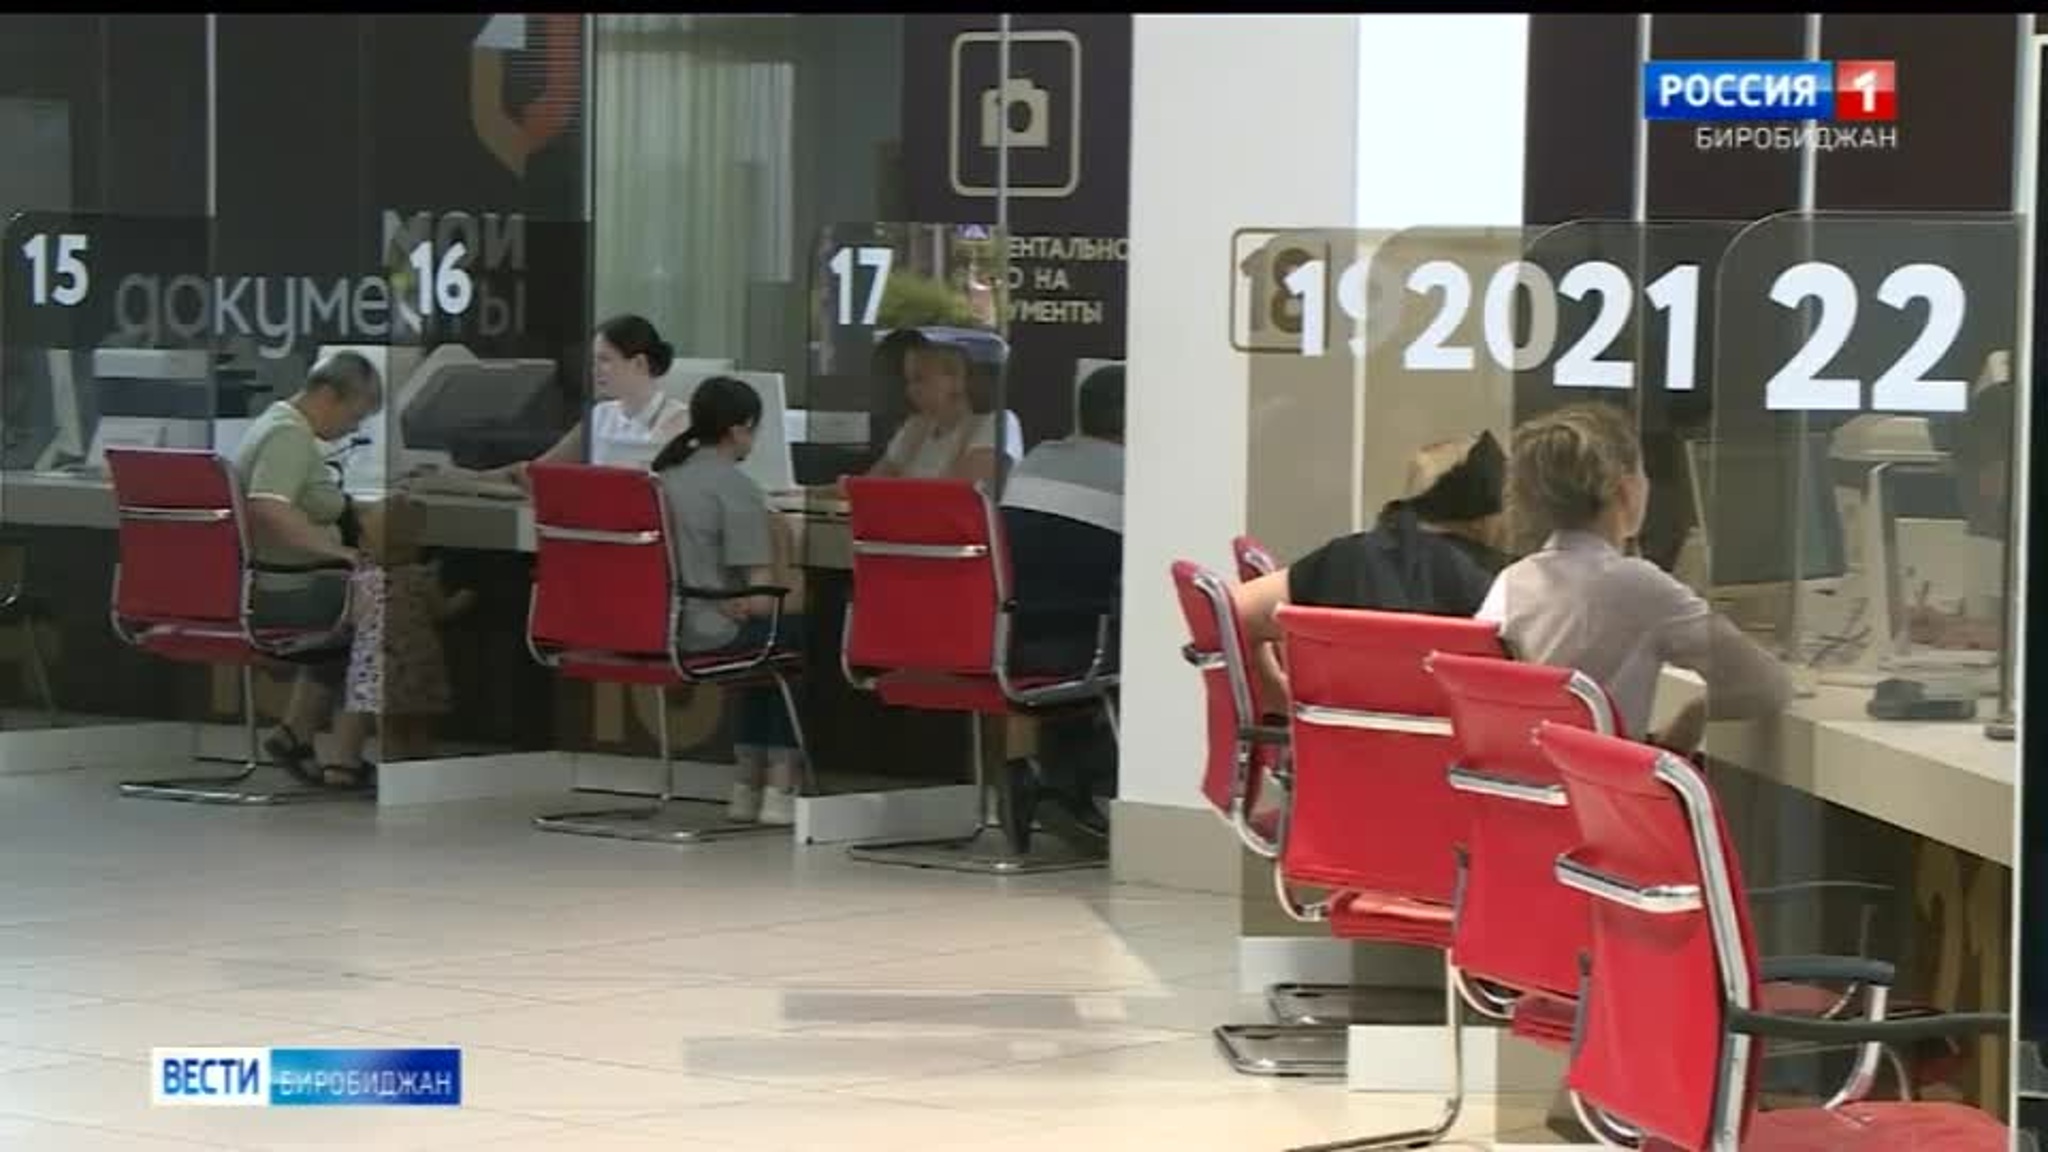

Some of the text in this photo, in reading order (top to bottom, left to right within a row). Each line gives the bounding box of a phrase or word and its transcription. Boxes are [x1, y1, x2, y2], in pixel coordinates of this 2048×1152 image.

[22, 233, 90, 306] 15
[408, 240, 473, 315] 16
[829, 246, 893, 325] 17
[1007, 236, 1129, 261] ЕНТАЛЬНО
[1034, 267, 1071, 291] НА
[1402, 259, 1558, 371] 20
[1553, 260, 1702, 391] 21
[1765, 260, 1970, 412] 22
